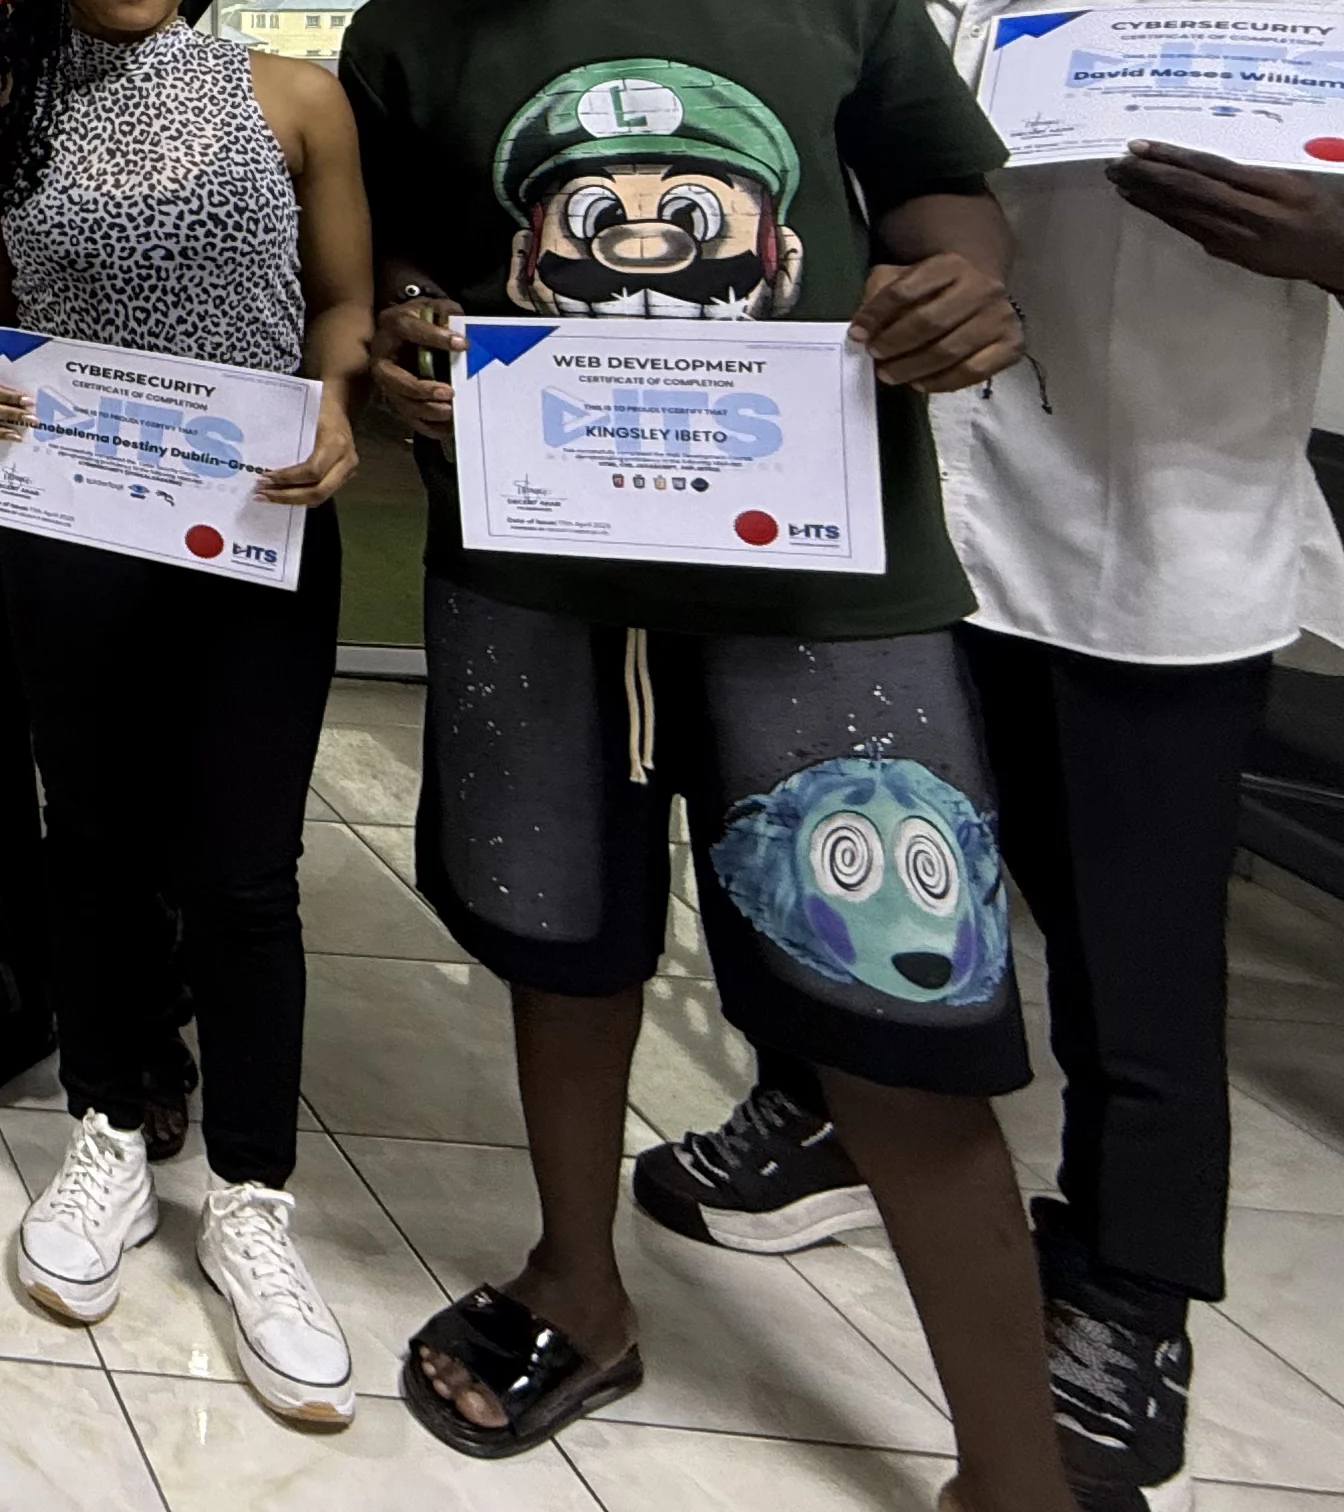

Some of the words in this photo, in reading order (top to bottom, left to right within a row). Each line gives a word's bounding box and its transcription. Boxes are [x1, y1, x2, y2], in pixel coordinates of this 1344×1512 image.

[1111, 20, 1335, 36] CYBERSECURITY
[1073, 67, 1144, 81] David
[1149, 68, 1233, 80] Moses
[610, 86, 648, 127] L
[553, 355, 602, 368] WEB
[607, 356, 767, 373] DEVELOPMENT
[66, 361, 216, 397] CYBERSECURITY
[578, 375, 644, 385] CERTIFICATE
[647, 377, 660, 385] OF
[663, 378, 734, 388] COMPLETION
[72, 380, 129, 396] CERTIFICATE
[131, 390, 144, 399] OF
[146, 393, 208, 411] COMPLETION
[585, 426, 671, 440] KINGSLEY
[675, 430, 728, 443] IBETO
[112, 435, 168, 457] Destiny
